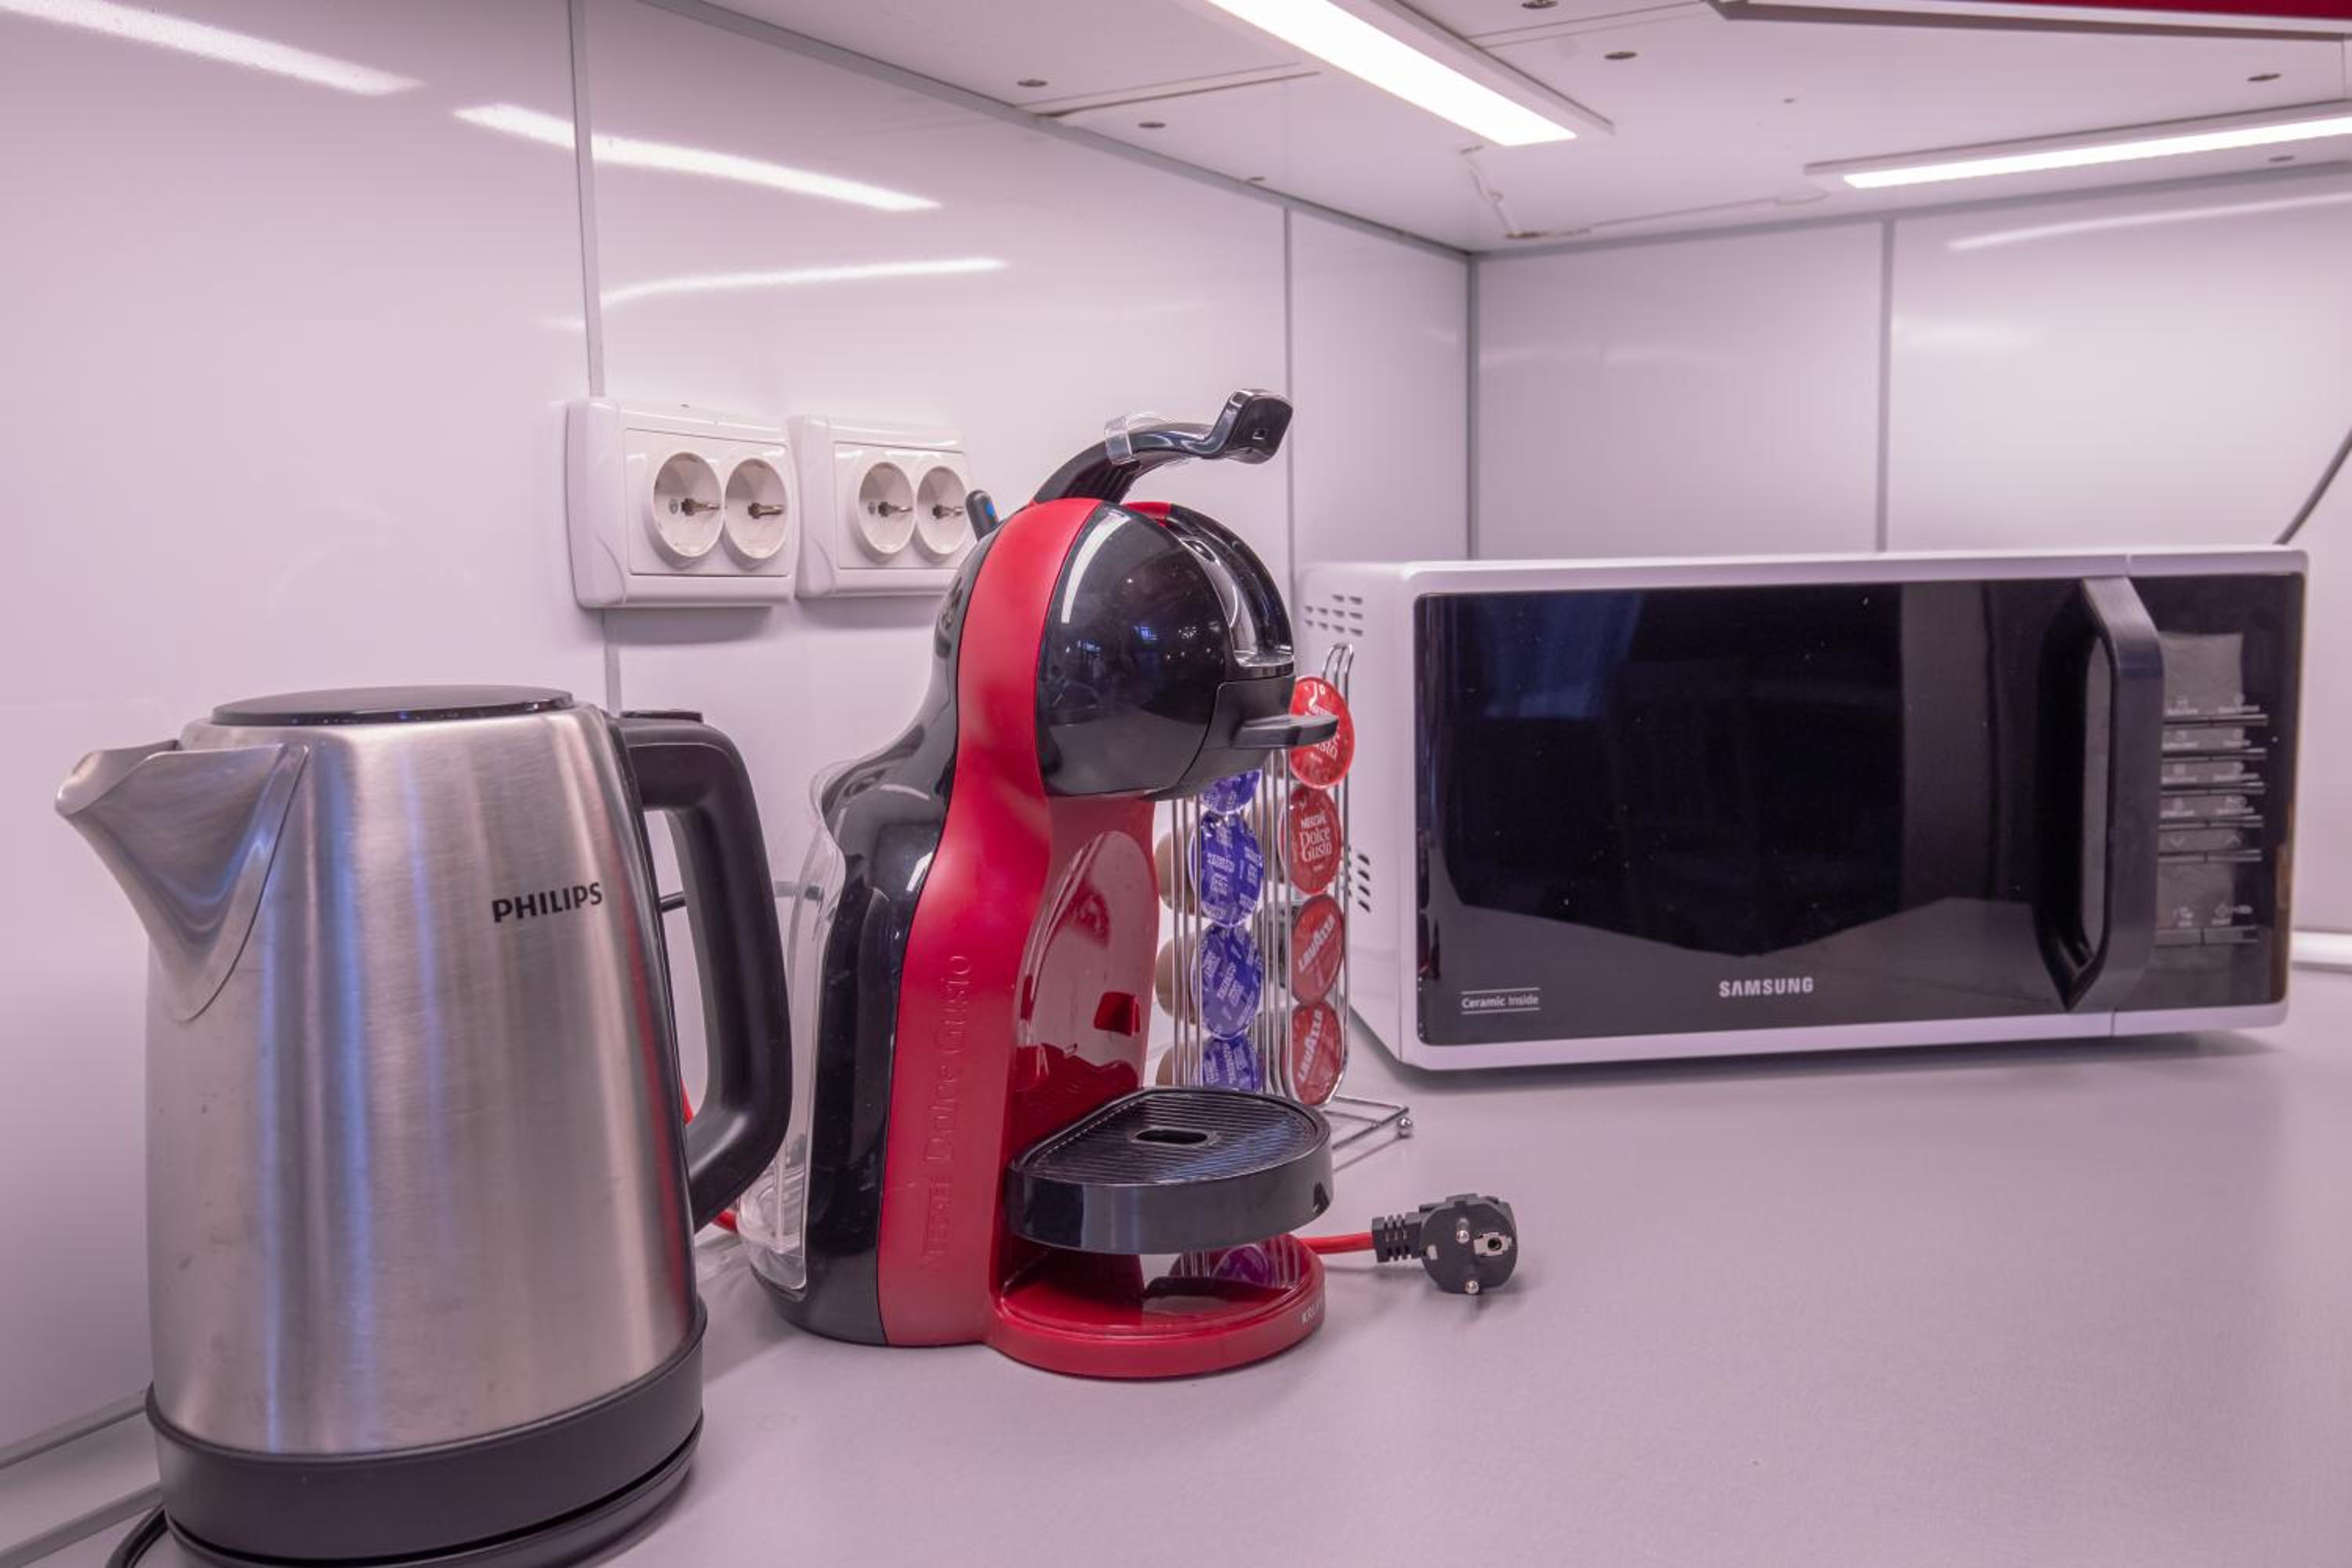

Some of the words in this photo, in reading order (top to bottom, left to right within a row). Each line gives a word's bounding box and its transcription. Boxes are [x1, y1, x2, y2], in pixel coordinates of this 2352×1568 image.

[1300, 827, 1330, 848] Dolce
[1301, 842, 1332, 862] Gusto
[492, 881, 603, 924] PHILIPS
[1719, 976, 1814, 998] SAMSUNG
[1461, 996, 1505, 1009] Ceramic
[1508, 993, 1539, 1005] Inside
